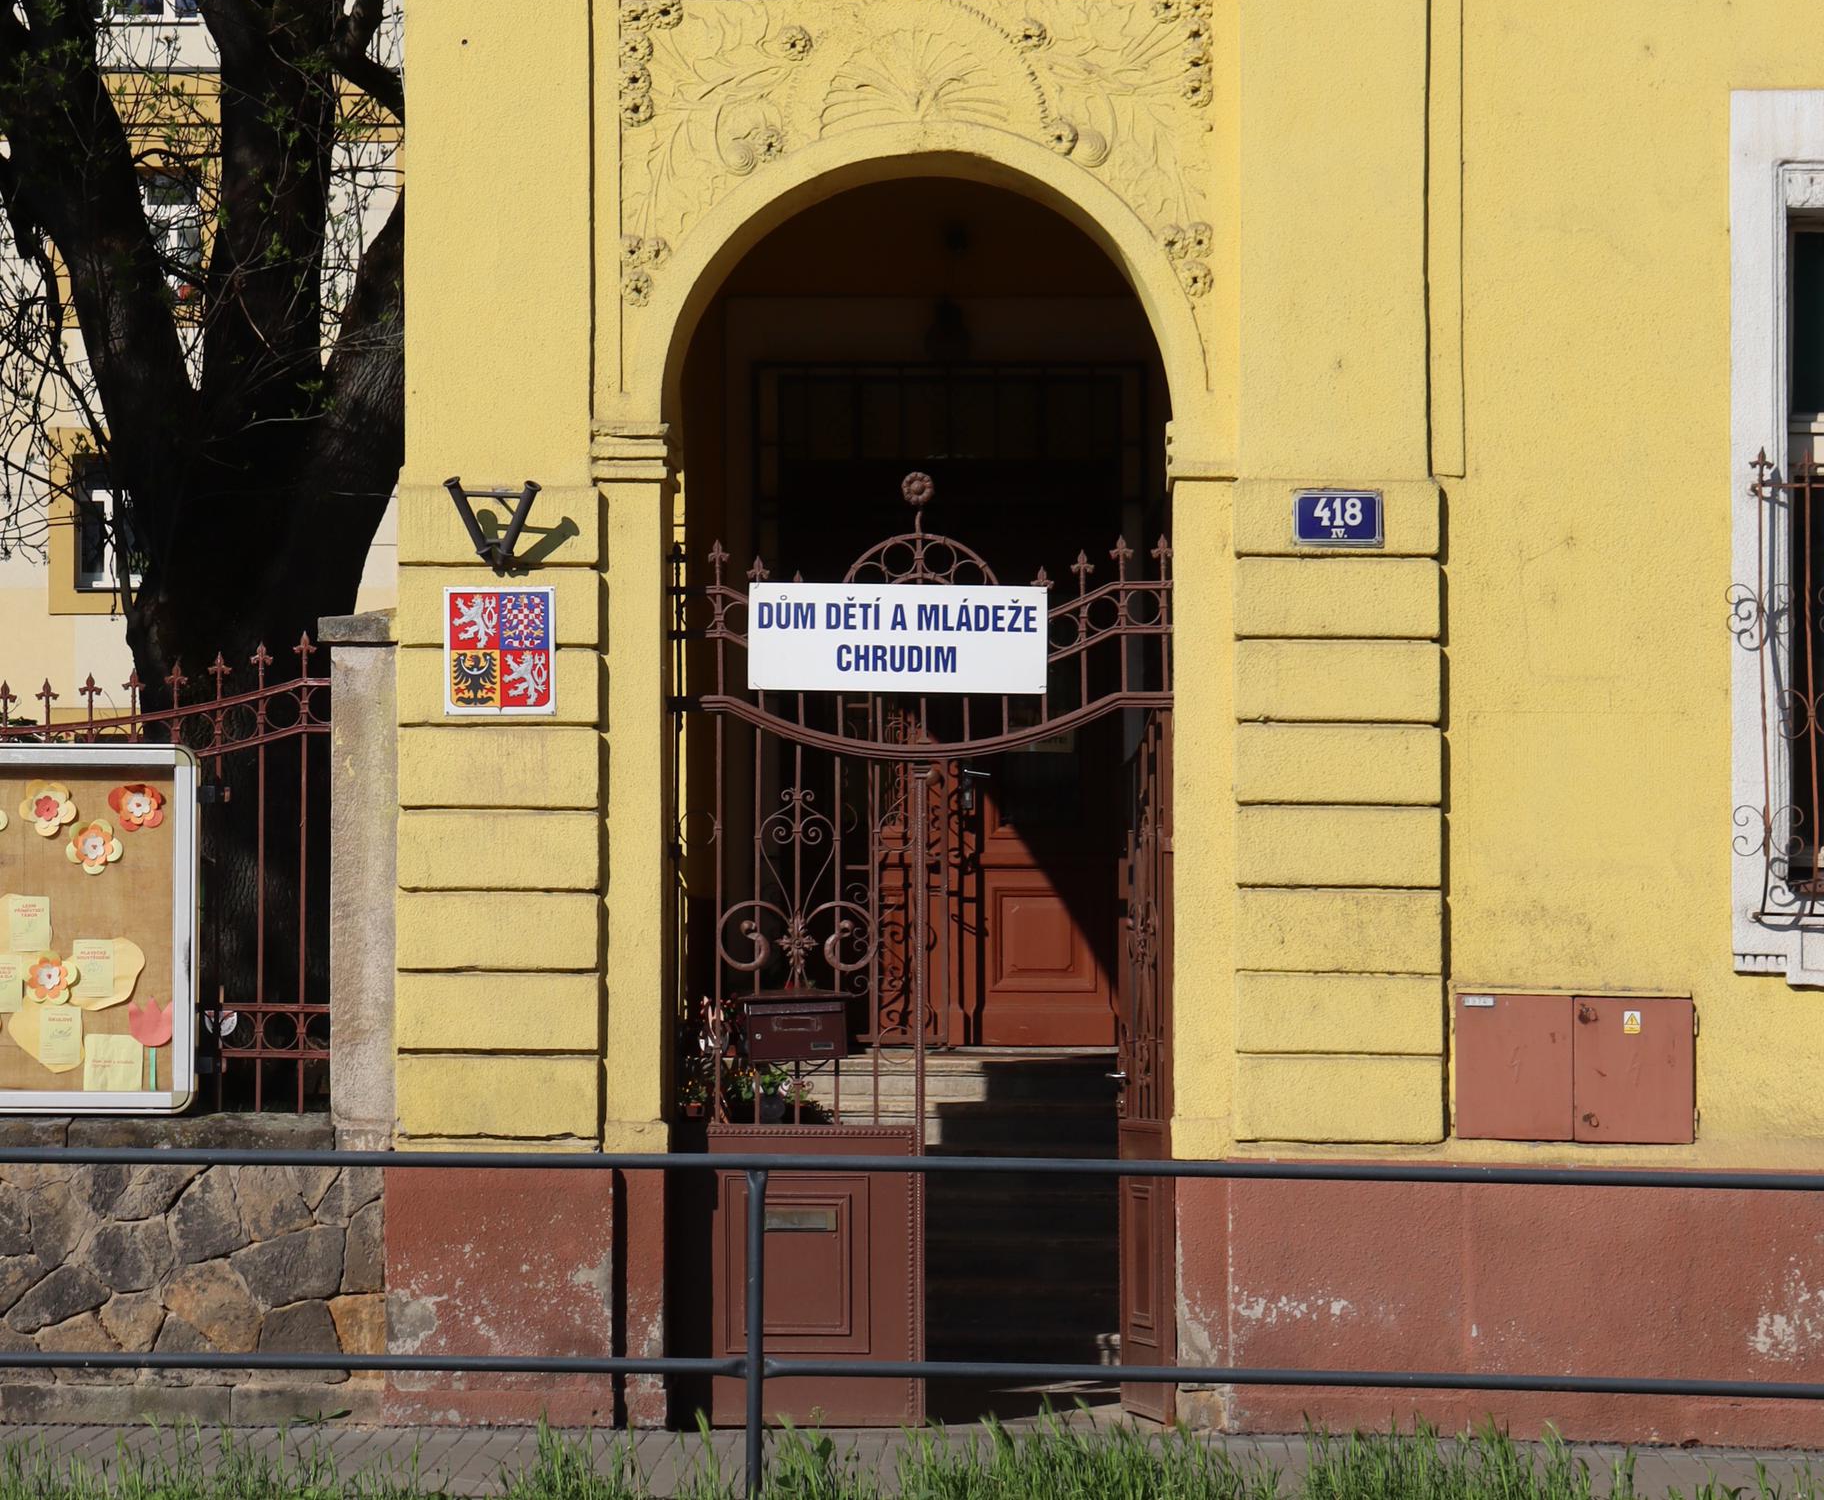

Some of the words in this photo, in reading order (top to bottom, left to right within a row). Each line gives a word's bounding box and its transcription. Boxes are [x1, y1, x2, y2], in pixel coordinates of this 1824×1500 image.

[1313, 497, 1363, 527] 418
[1330, 528, 1348, 539] IV.
[757, 594, 816, 630] DŮM
[825, 596, 882, 631] DĚTÍ
[890, 603, 908, 631] A
[917, 598, 1038, 633] MLÁDEŽE
[836, 644, 958, 673] CHRUDIM
